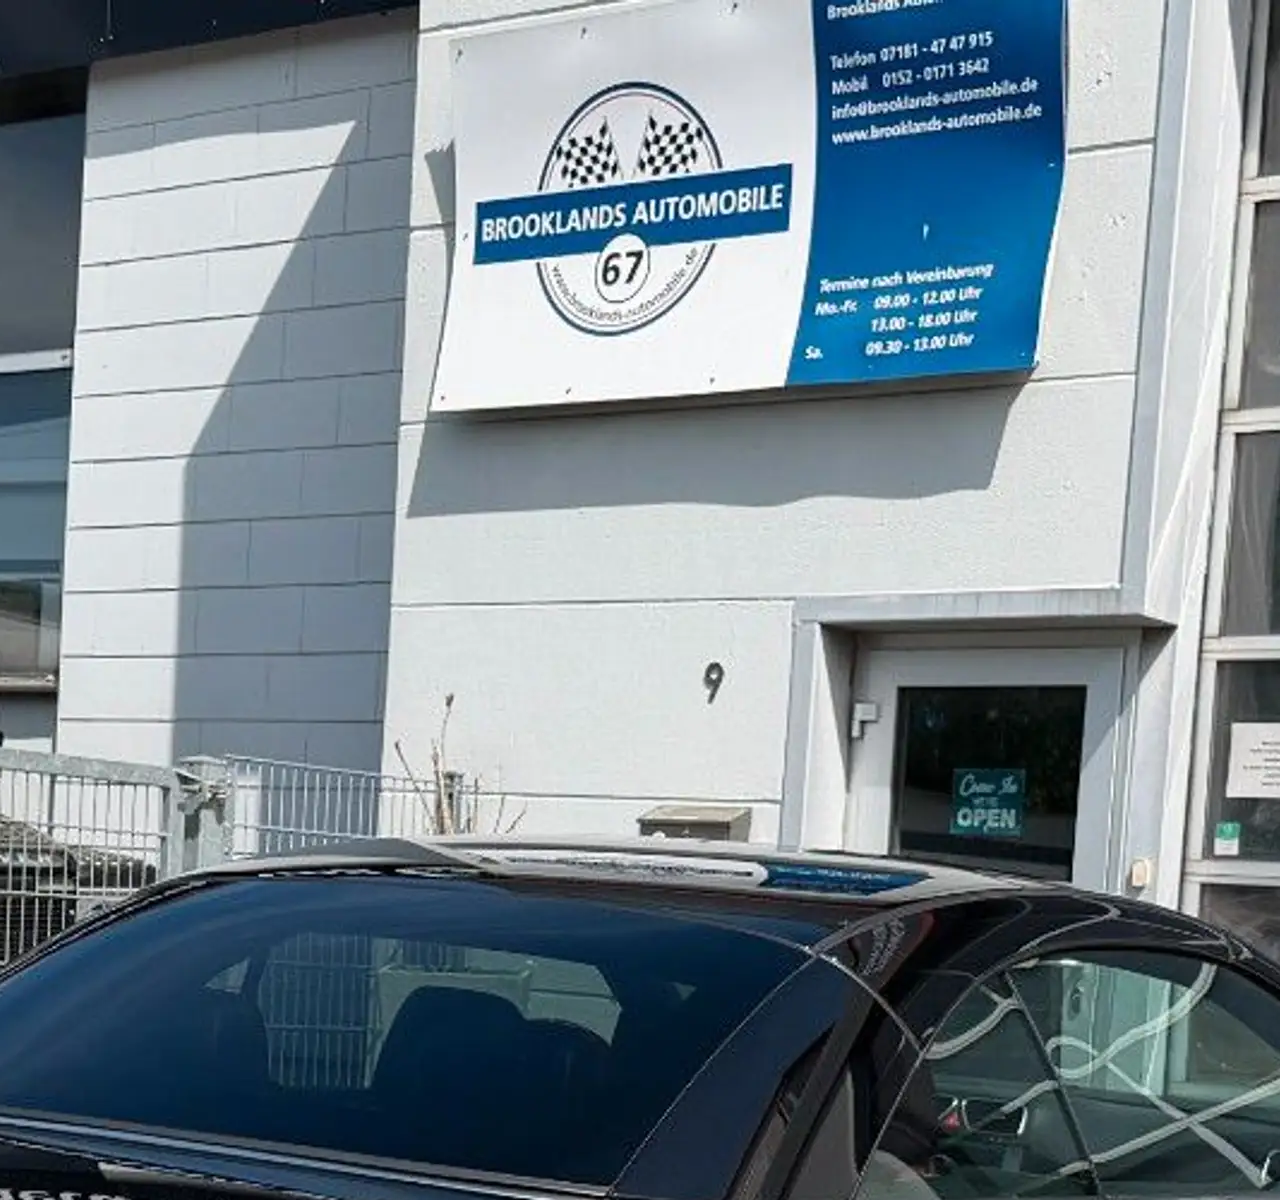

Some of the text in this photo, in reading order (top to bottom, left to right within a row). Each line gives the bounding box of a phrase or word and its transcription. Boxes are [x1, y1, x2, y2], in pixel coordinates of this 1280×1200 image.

[830, 50, 876, 70] Telefon
[880, 43, 918, 62] 07181
[931, 38, 946, 54] 47
[949, 35, 965, 52] 47
[969, 31, 993, 48] 915
[832, 74, 868, 94] Mobil
[882, 70, 913, 88] 0152
[923, 64, 954, 81] 0171
[831, 76, 1038, 120] info@brooklands-automobile.de
[831, 103, 1043, 145] www.brooklands-automobile.de
[481, 183, 785, 243] BROOKLANDS AUTOMOBILE
[601, 249, 645, 286] 67
[820, 263, 995, 294] Termine nach Vereinbarung
[873, 292, 911, 310] 09.00
[922, 287, 956, 306] 12.00
[959, 284, 984, 301] Uhr
[870, 316, 906, 334] 13.00
[954, 308, 979, 324] Uhr
[804, 345, 824, 360] Sa.
[949, 330, 975, 347] Uhr
[703, 661, 725, 705] 9
[956, 807, 1017, 830] OPEN
